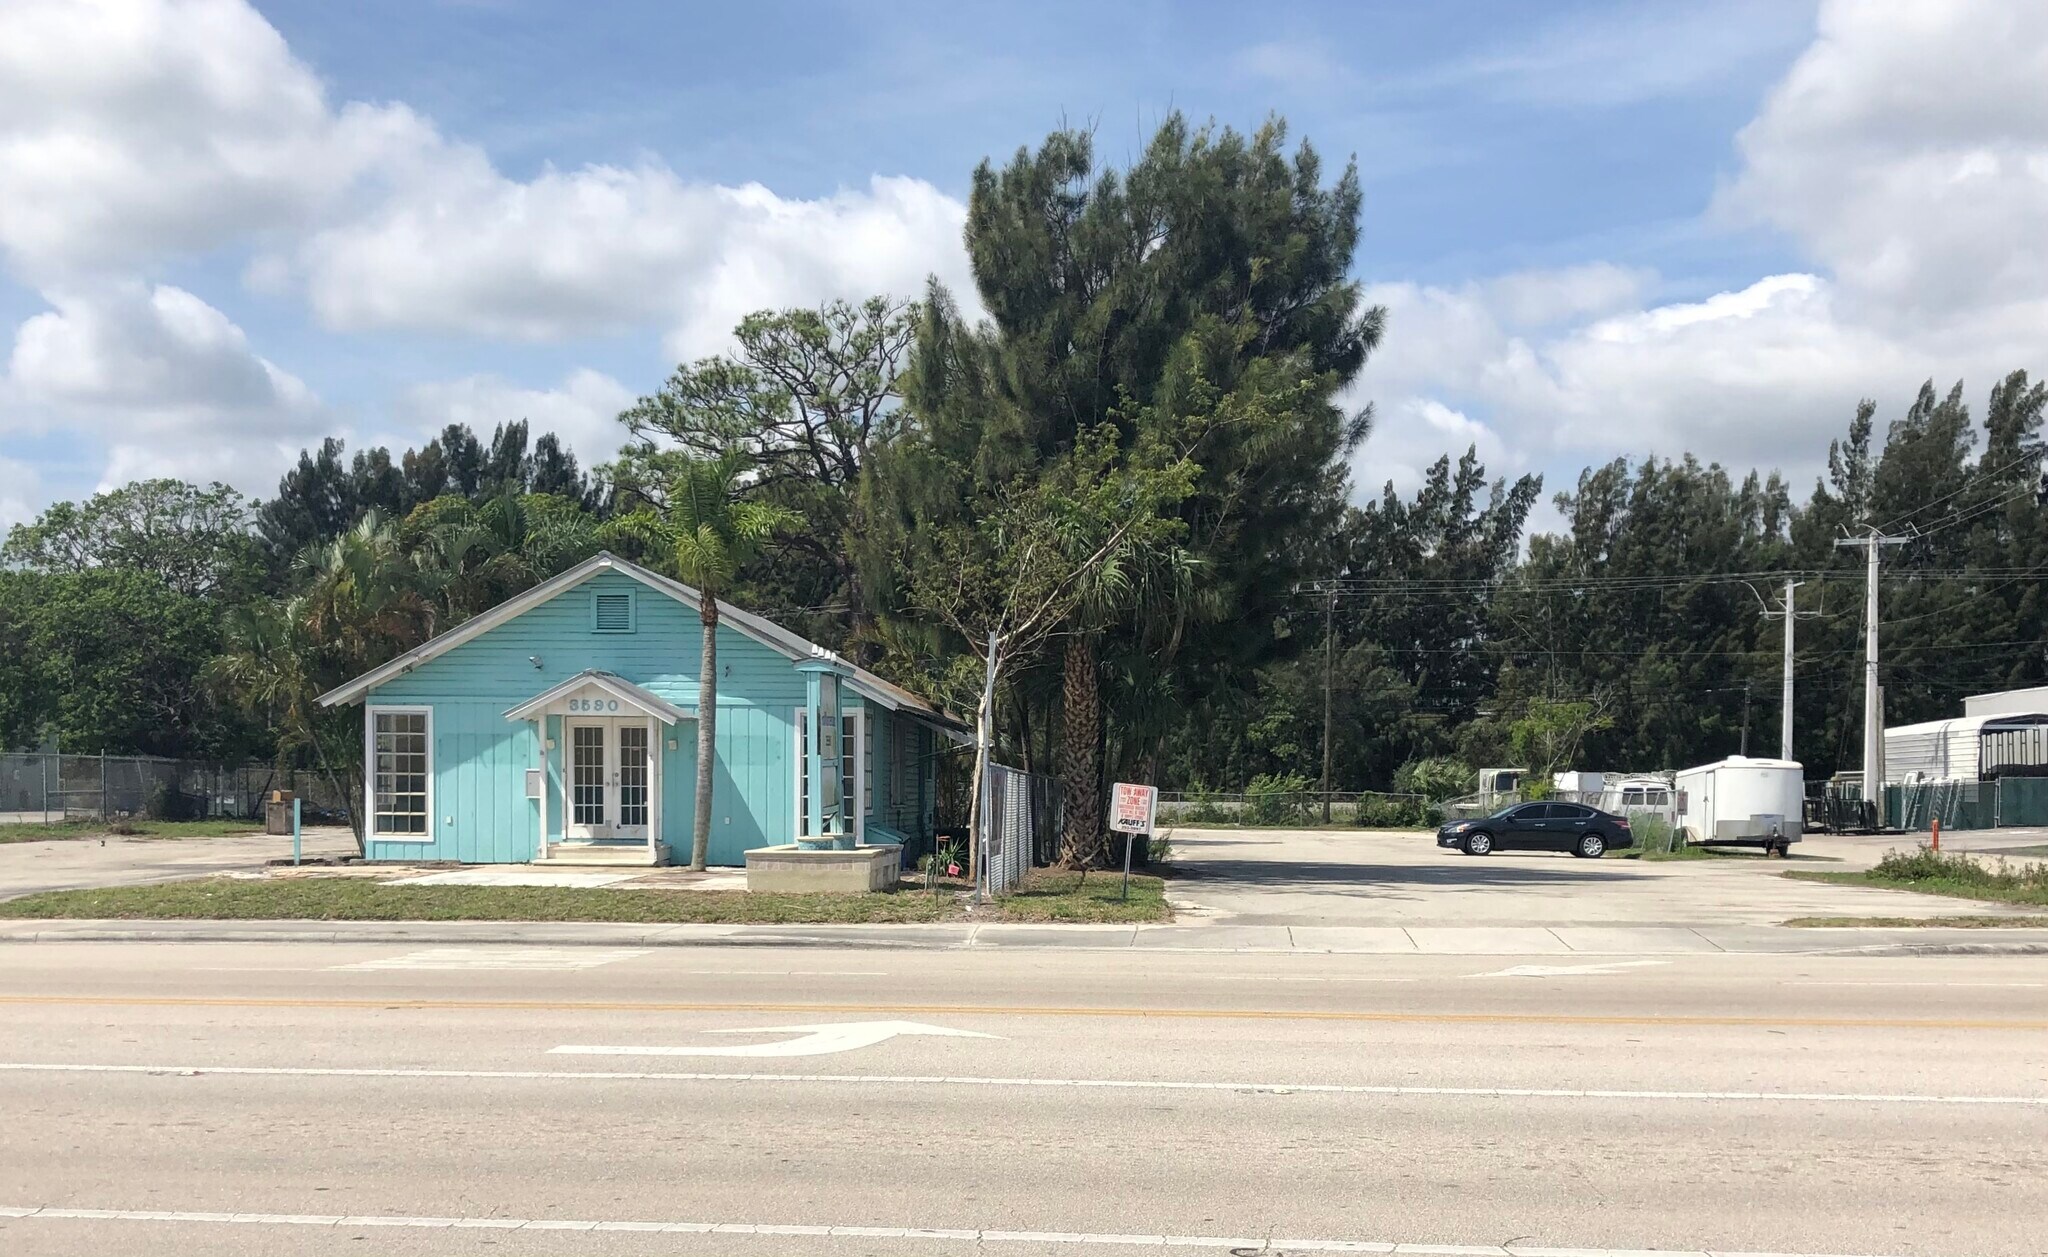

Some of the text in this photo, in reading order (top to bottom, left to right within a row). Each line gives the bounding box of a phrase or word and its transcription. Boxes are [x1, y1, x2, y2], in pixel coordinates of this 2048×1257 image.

[569, 699, 618, 711] 3590
[1121, 787, 1149, 797] TOW AWAY
[1127, 796, 1140, 805] ZONE
